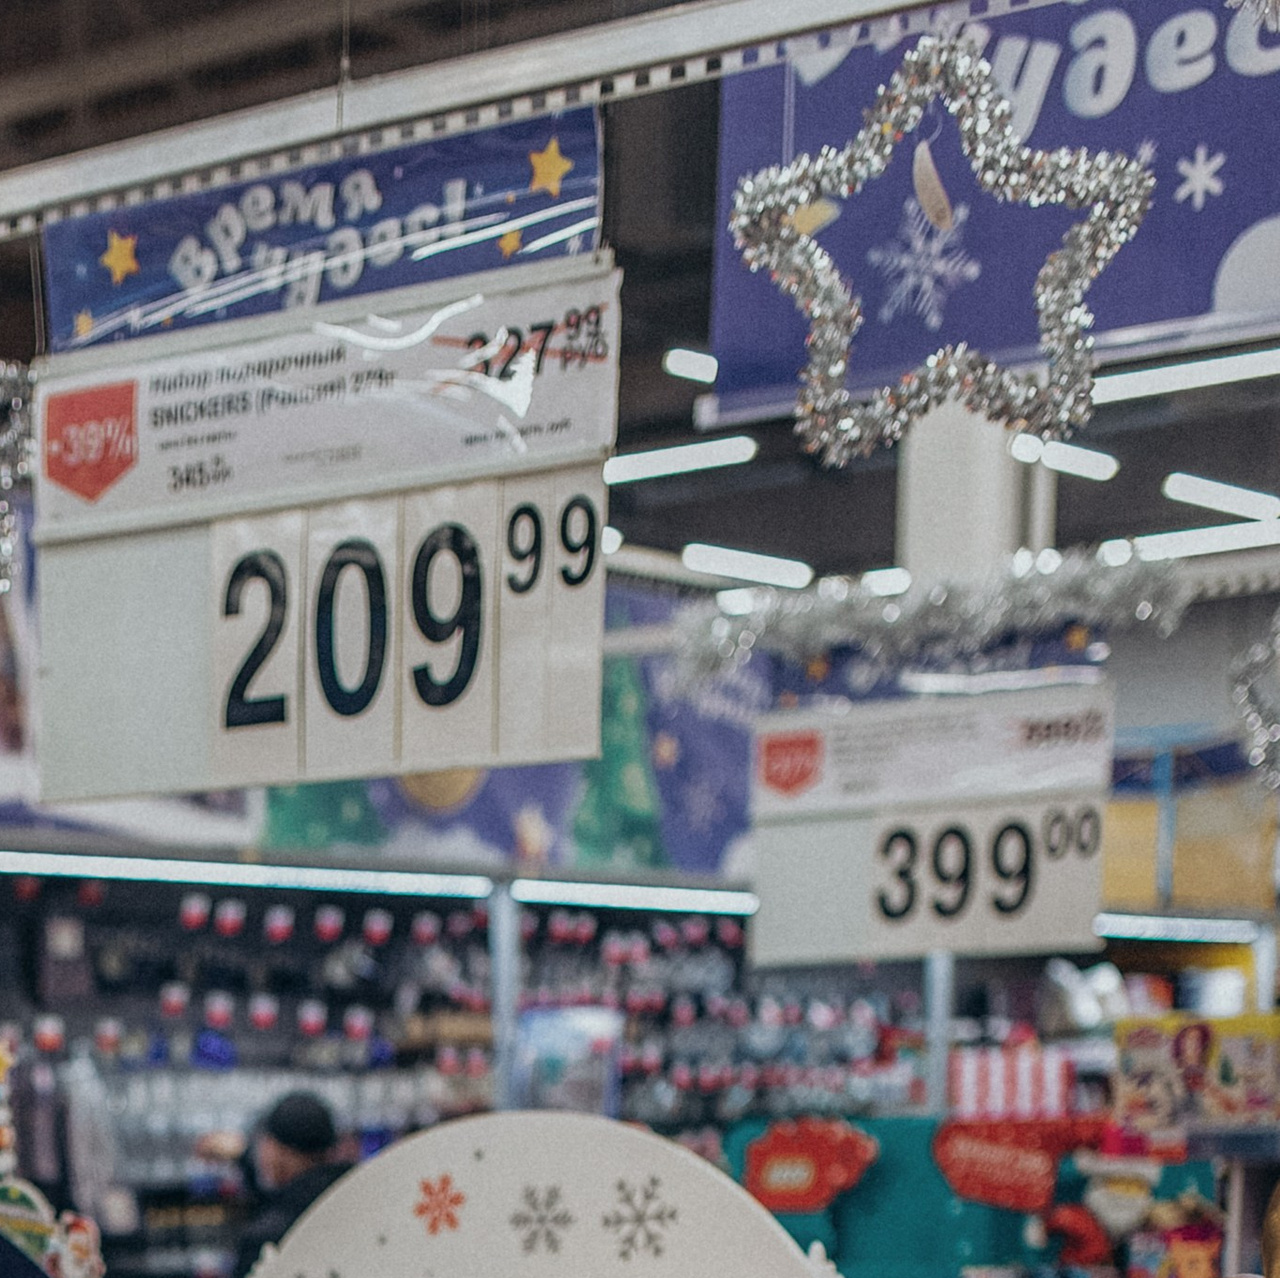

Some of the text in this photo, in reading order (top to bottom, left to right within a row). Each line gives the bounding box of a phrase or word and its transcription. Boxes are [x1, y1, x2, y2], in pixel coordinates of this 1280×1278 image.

[224, 494, 597, 728] 209 99
[877, 806, 1101, 917] 399 00
